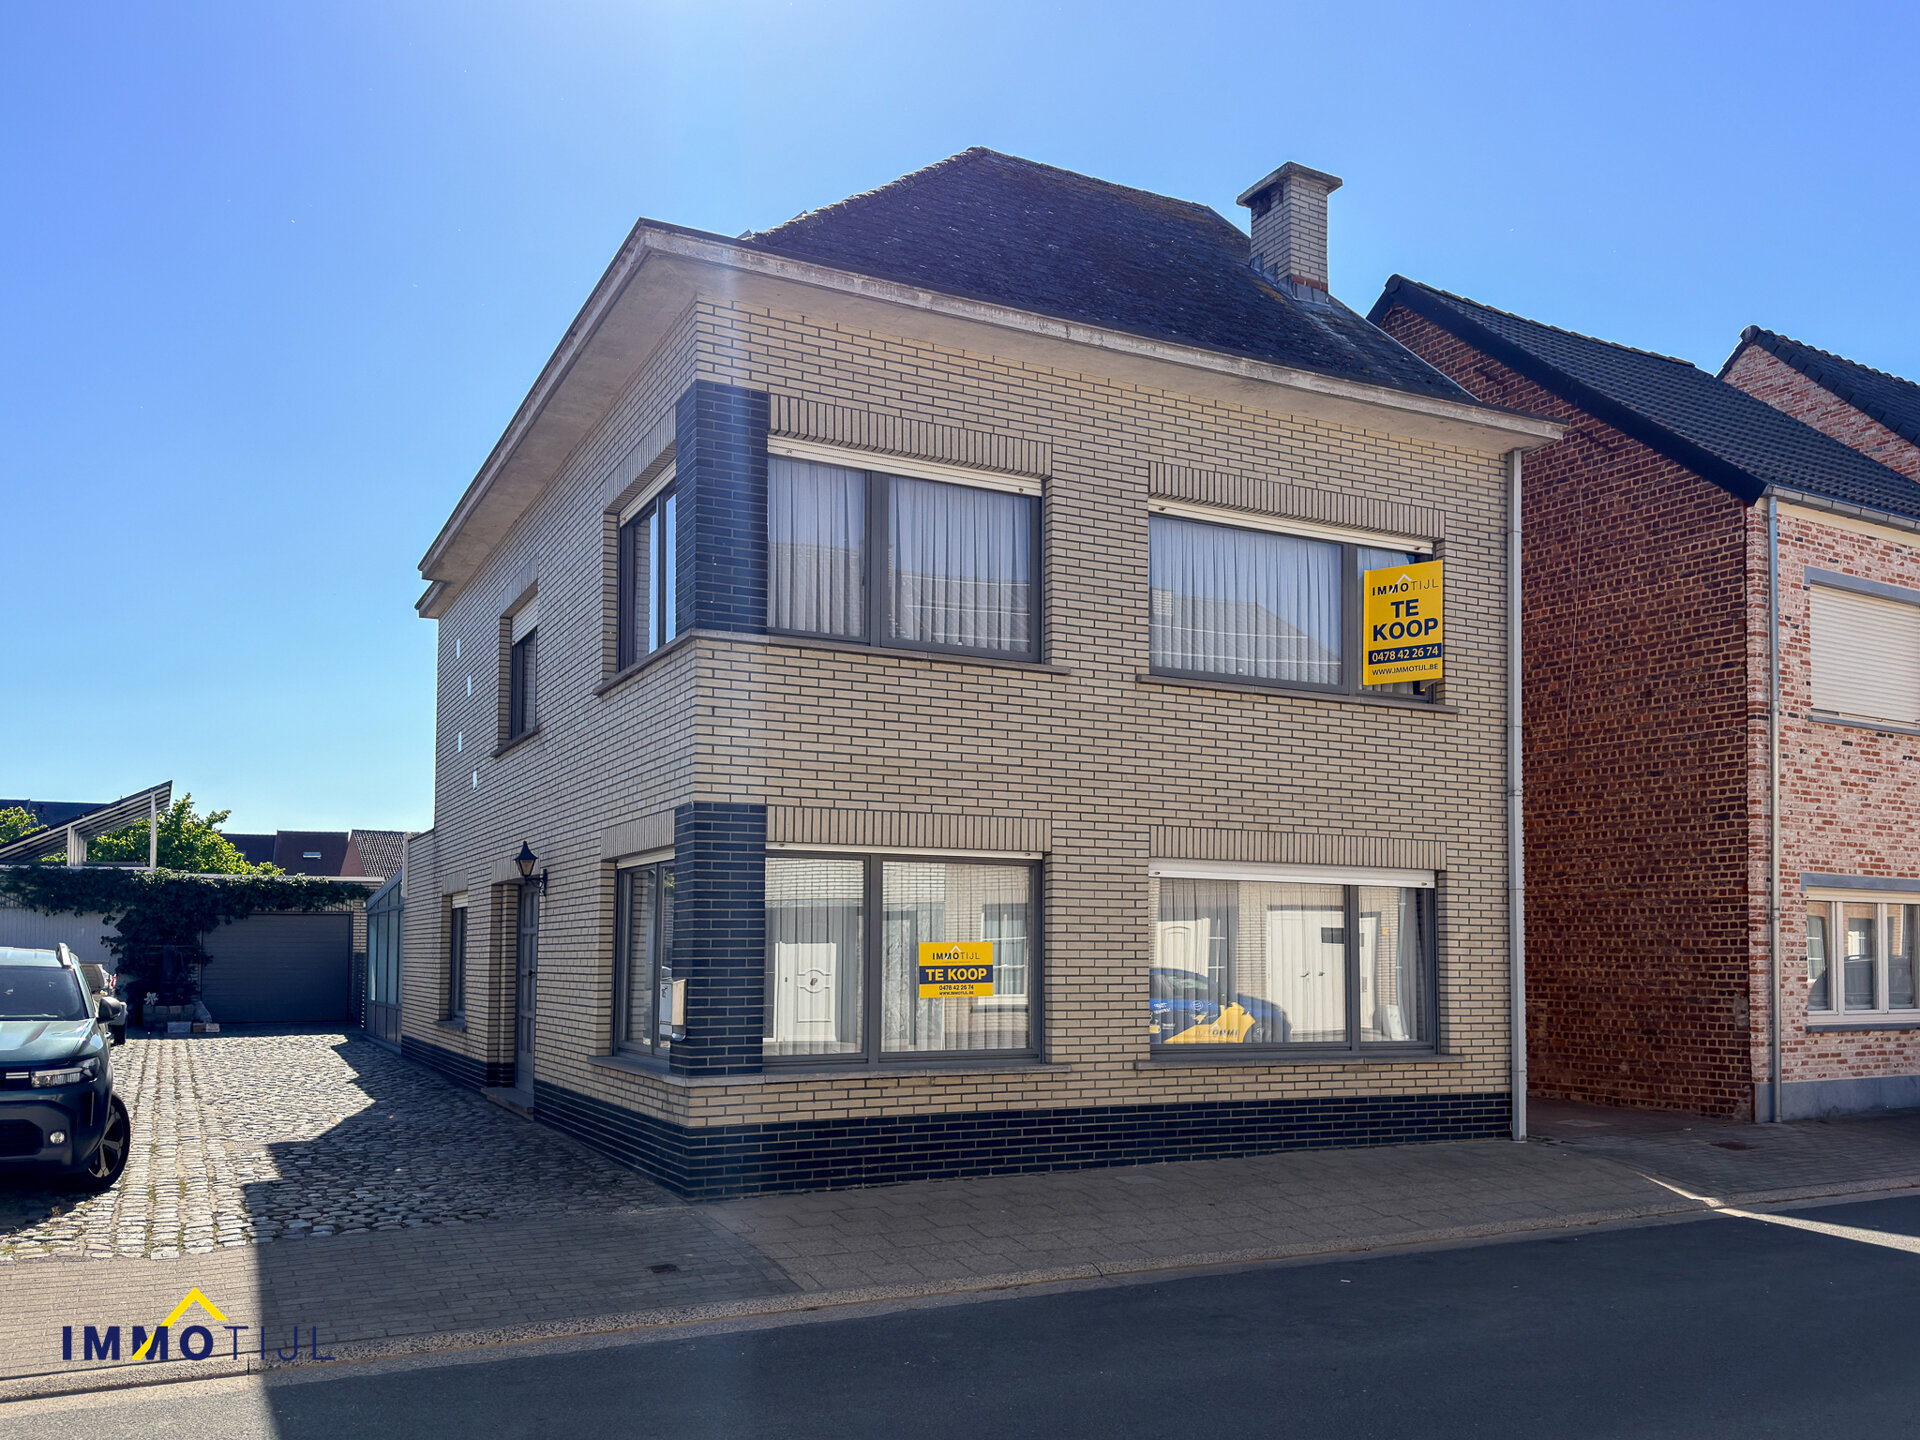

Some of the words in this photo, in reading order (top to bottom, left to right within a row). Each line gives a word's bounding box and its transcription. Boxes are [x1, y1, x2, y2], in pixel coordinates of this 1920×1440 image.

[1390, 598, 1420, 619] TE
[1372, 617, 1439, 642] KOOP
[1372, 650, 1396, 662] 0478
[1397, 649, 1410, 659] 42
[1412, 647, 1424, 658] 26
[1426, 645, 1439, 656] 74
[1372, 663, 1439, 676] WWW.IMMOTIJL.BE
[925, 969, 944, 981] TE
[948, 967, 987, 981] KOOP
